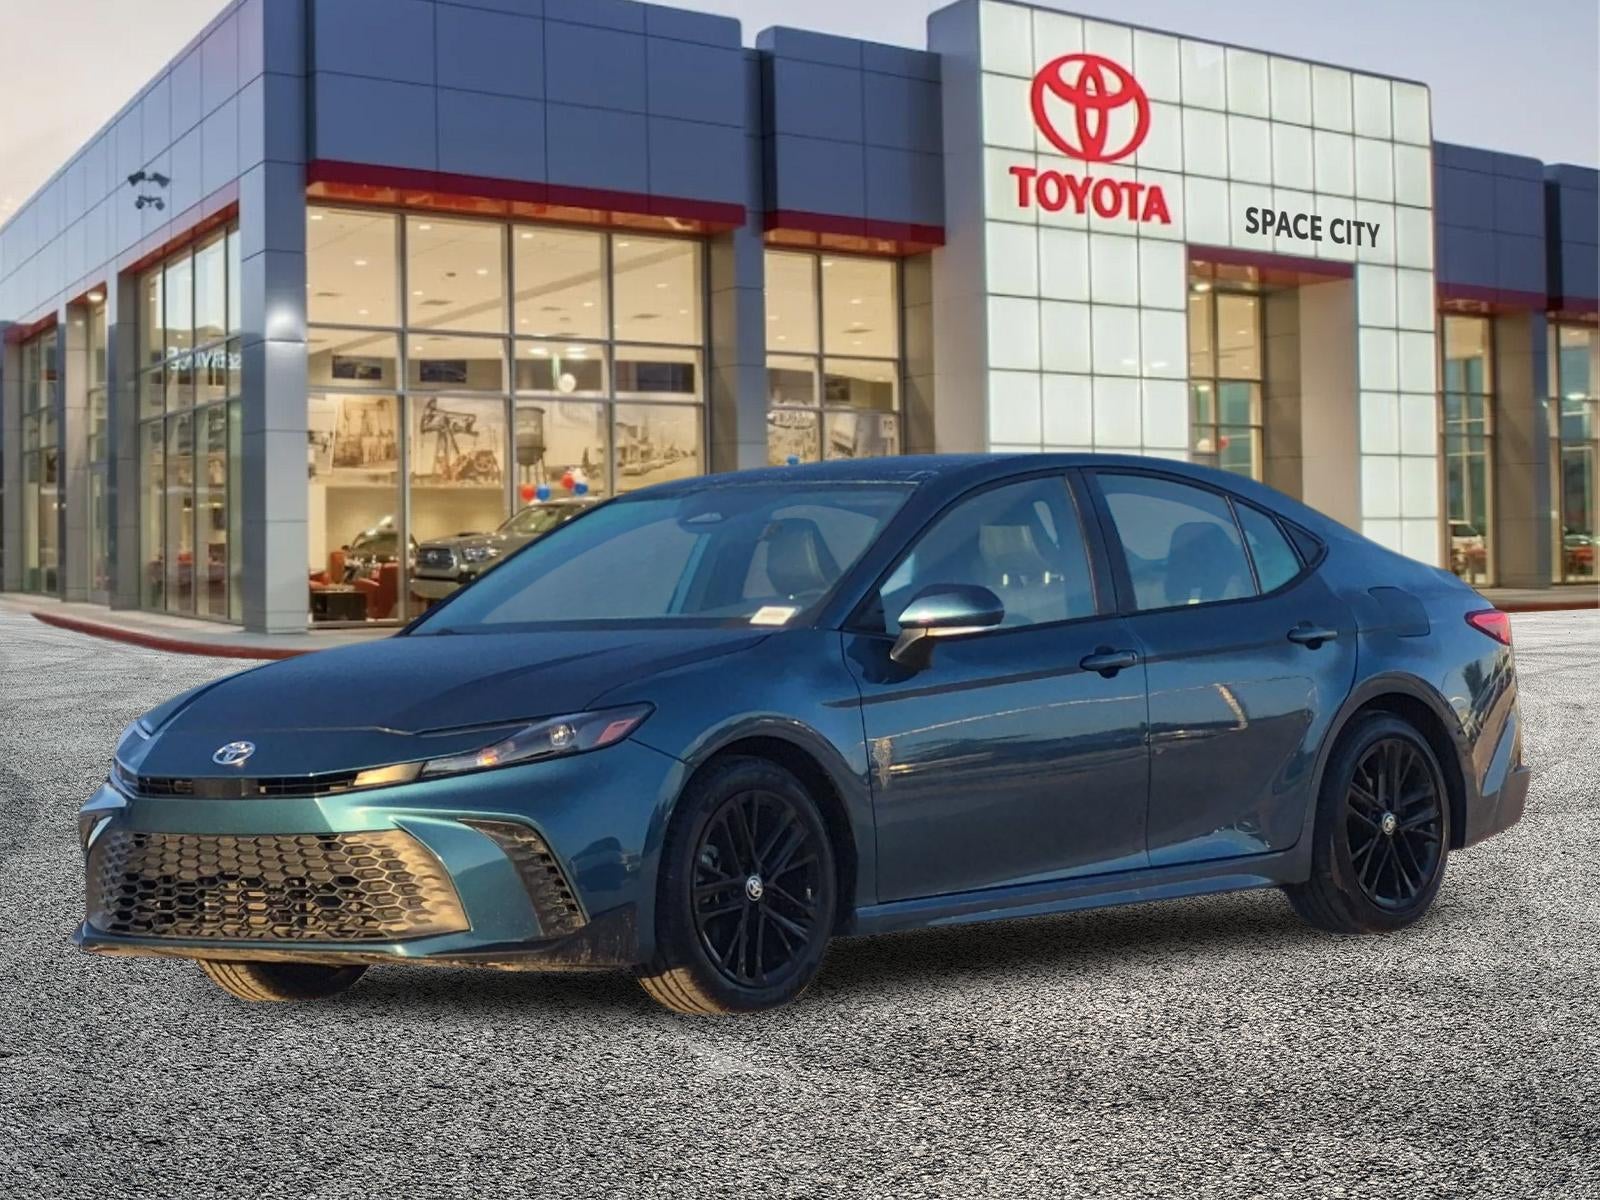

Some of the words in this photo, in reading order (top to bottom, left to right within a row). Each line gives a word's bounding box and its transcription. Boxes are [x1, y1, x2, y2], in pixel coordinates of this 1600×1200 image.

[1009, 166, 1171, 224] TOYOTA
[1246, 207, 1322, 241] SPACE
[1330, 219, 1380, 248] CITY
